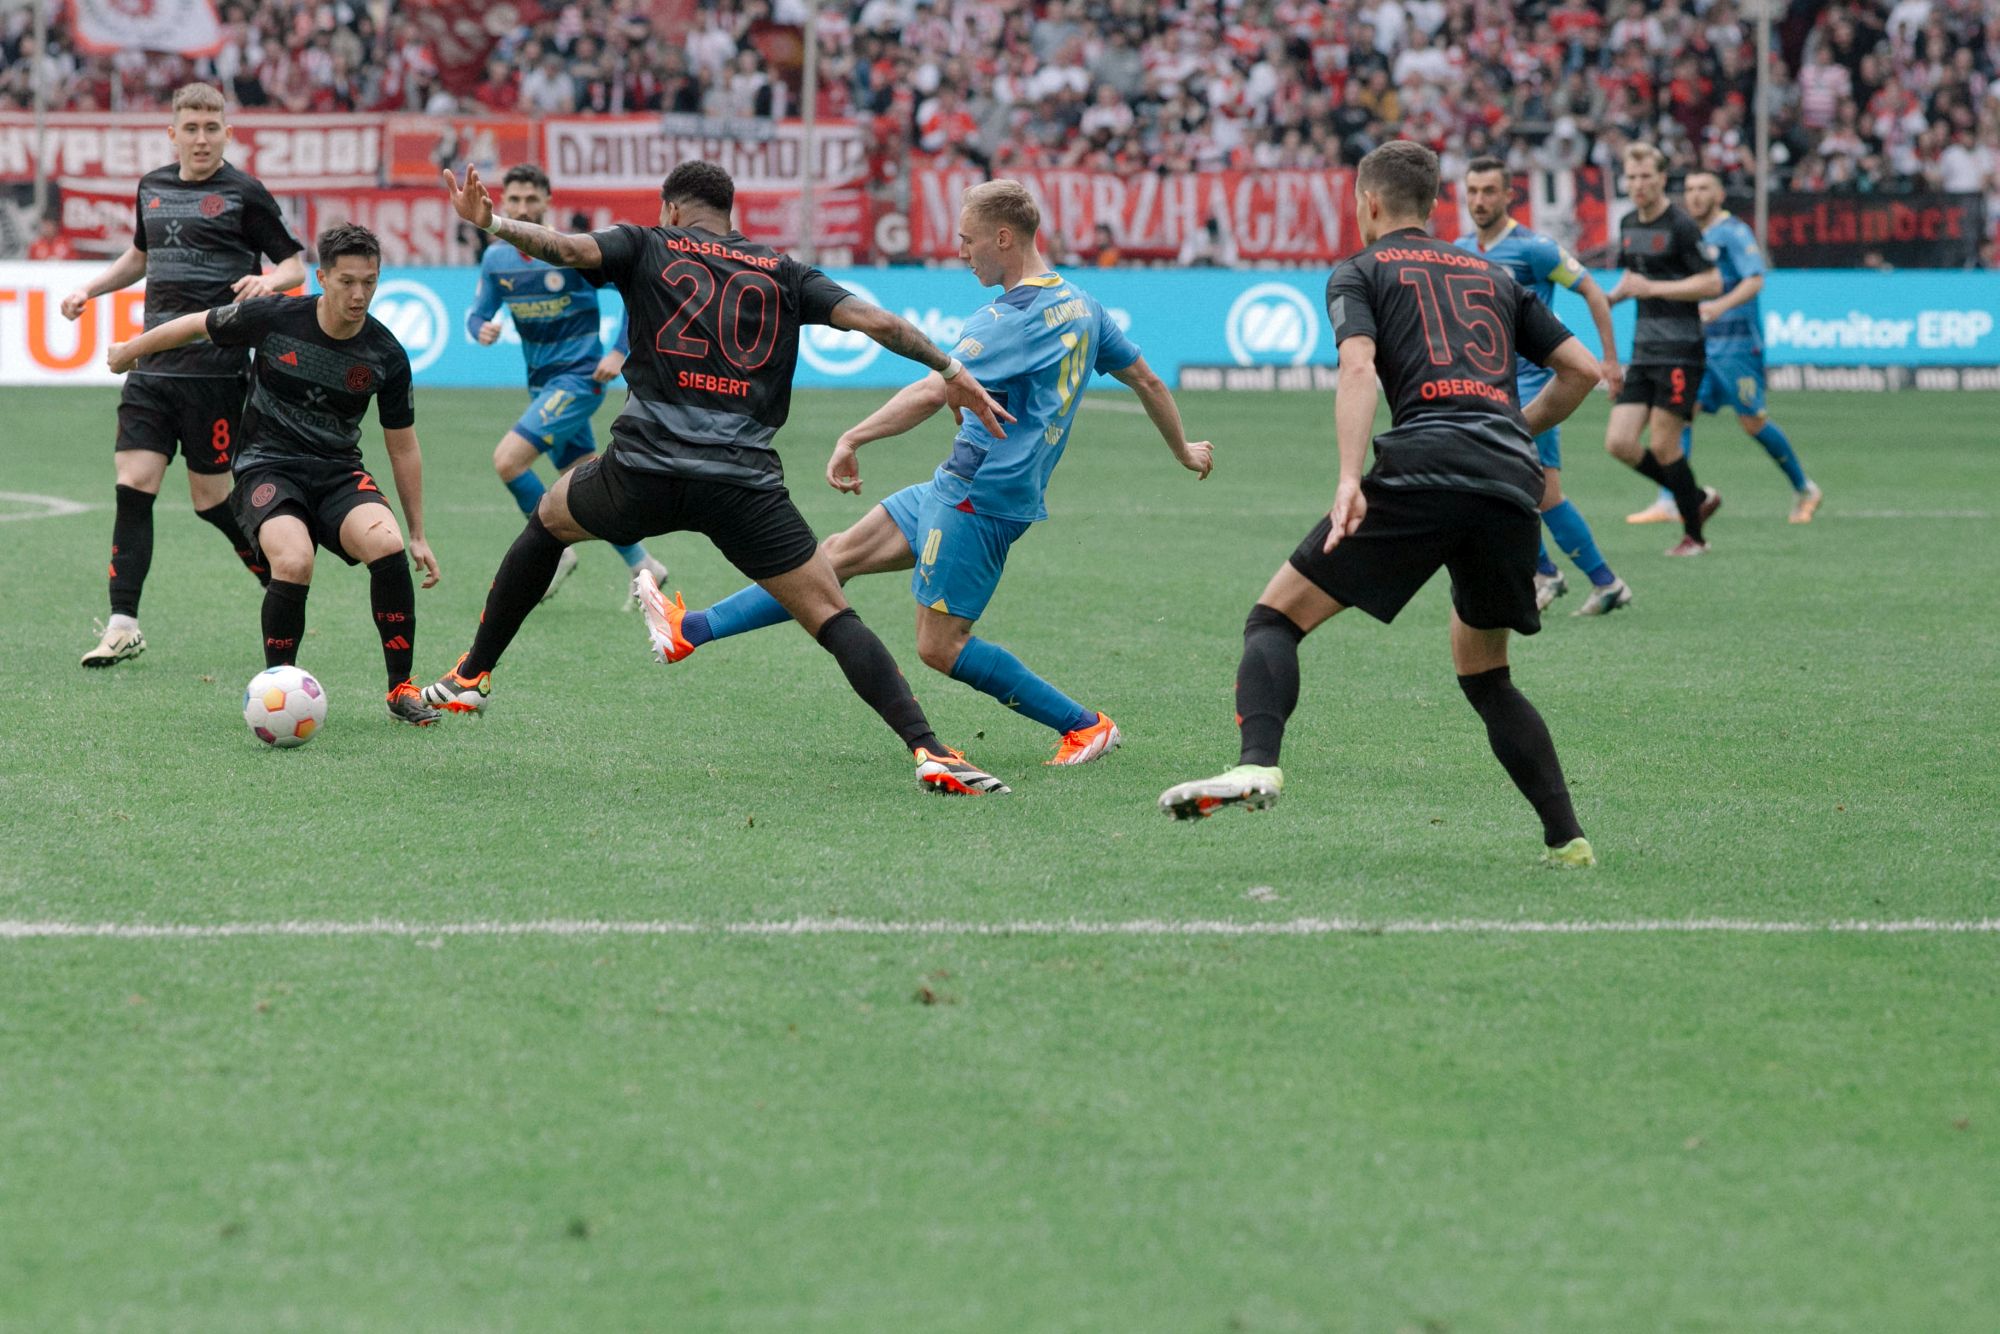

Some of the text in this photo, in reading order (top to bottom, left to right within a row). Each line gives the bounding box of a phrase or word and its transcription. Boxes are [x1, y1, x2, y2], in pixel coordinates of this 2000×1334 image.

[919, 170, 1343, 254] MNERZHAGEN
[667, 237, 779, 269] DÜSSELDORF
[1375, 247, 1489, 271] DÜSSELDORF
[656, 259, 780, 369] 20
[1400, 267, 1508, 375] 15
[1764, 310, 1993, 348] Monitor ERP
[678, 371, 750, 397] SIEBERT
[1421, 379, 1509, 404] OBERDOR
[212, 418, 230, 451] 8
[920, 528, 942, 566] 10
[377, 611, 405, 623] F95
[267, 637, 293, 650] F95
